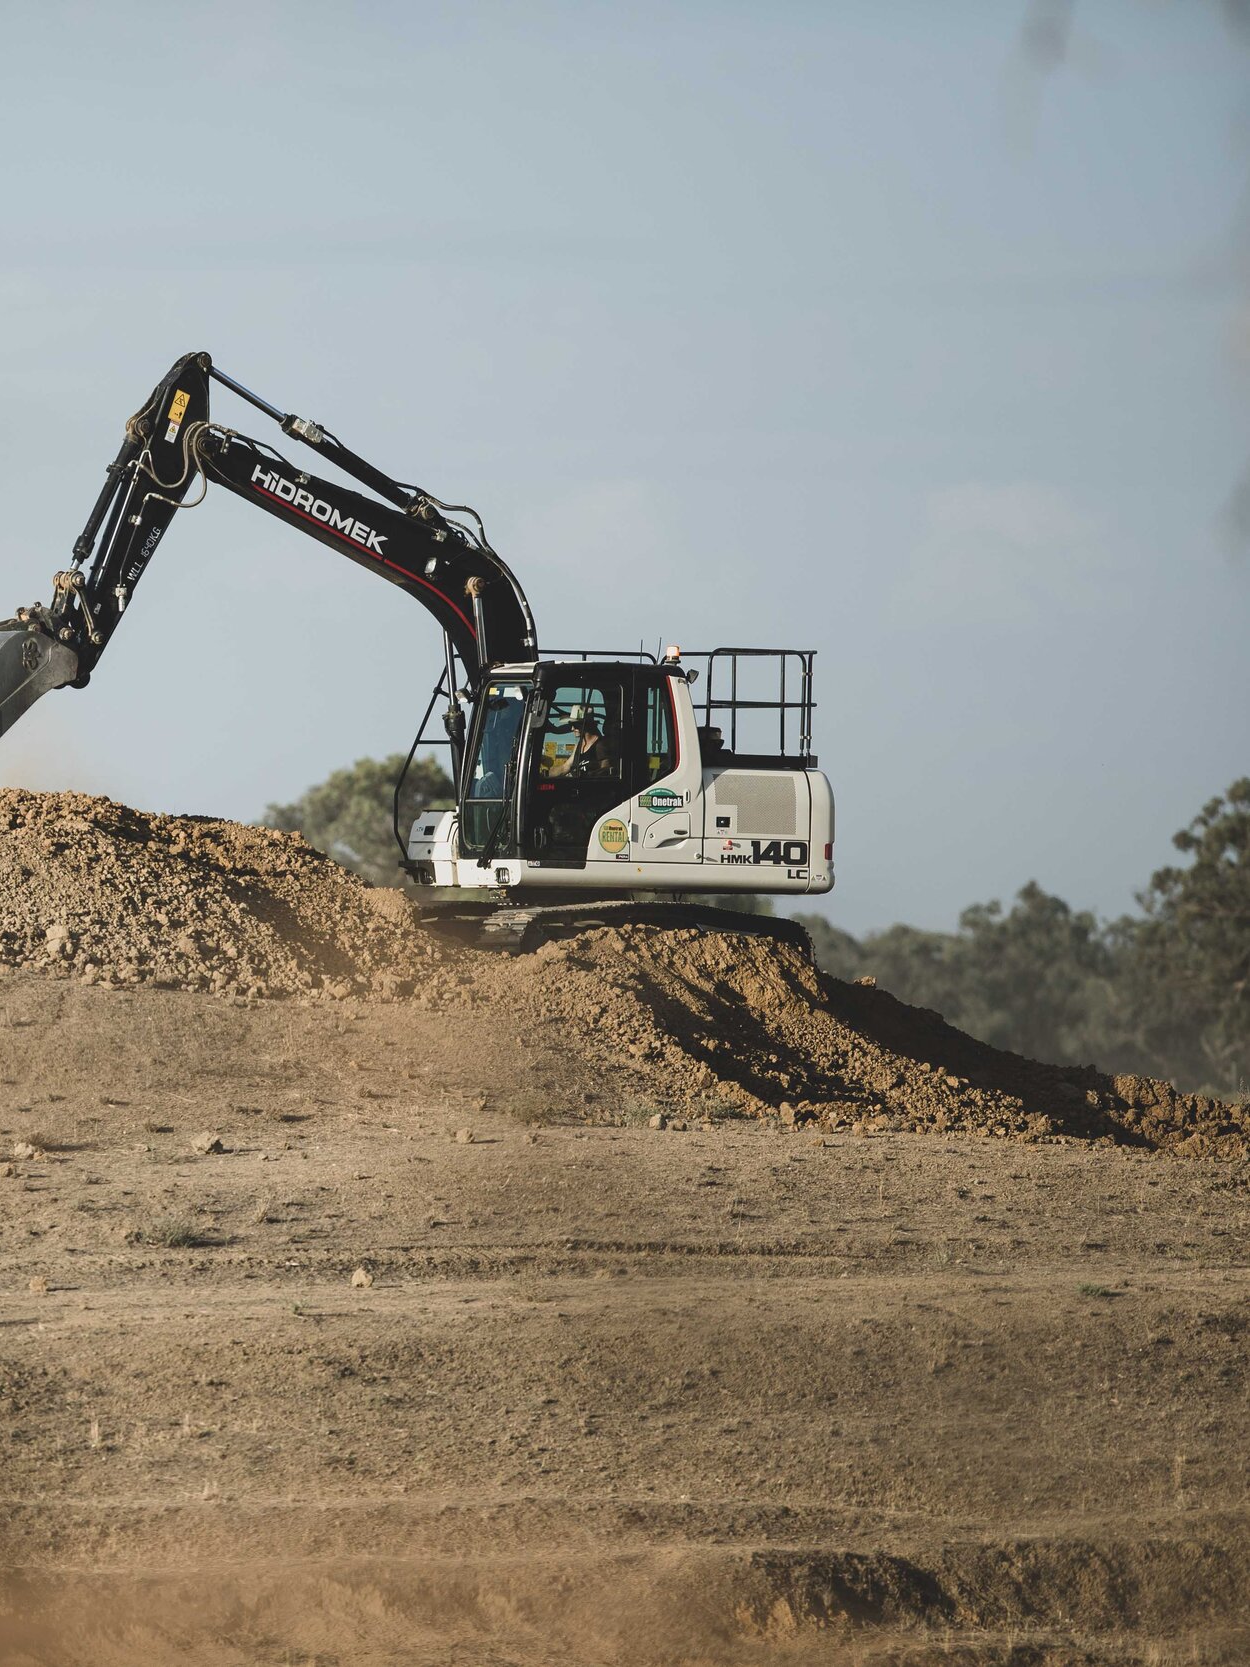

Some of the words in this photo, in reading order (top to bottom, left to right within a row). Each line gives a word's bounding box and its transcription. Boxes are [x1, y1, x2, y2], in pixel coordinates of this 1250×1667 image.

[127, 562, 144, 582] WLL
[652, 796, 683, 807] Onetrak
[601, 831, 626, 843] RENTAL
[720, 854, 752, 864] HMK
[750, 840, 808, 866] 140
[787, 869, 809, 879] LC
